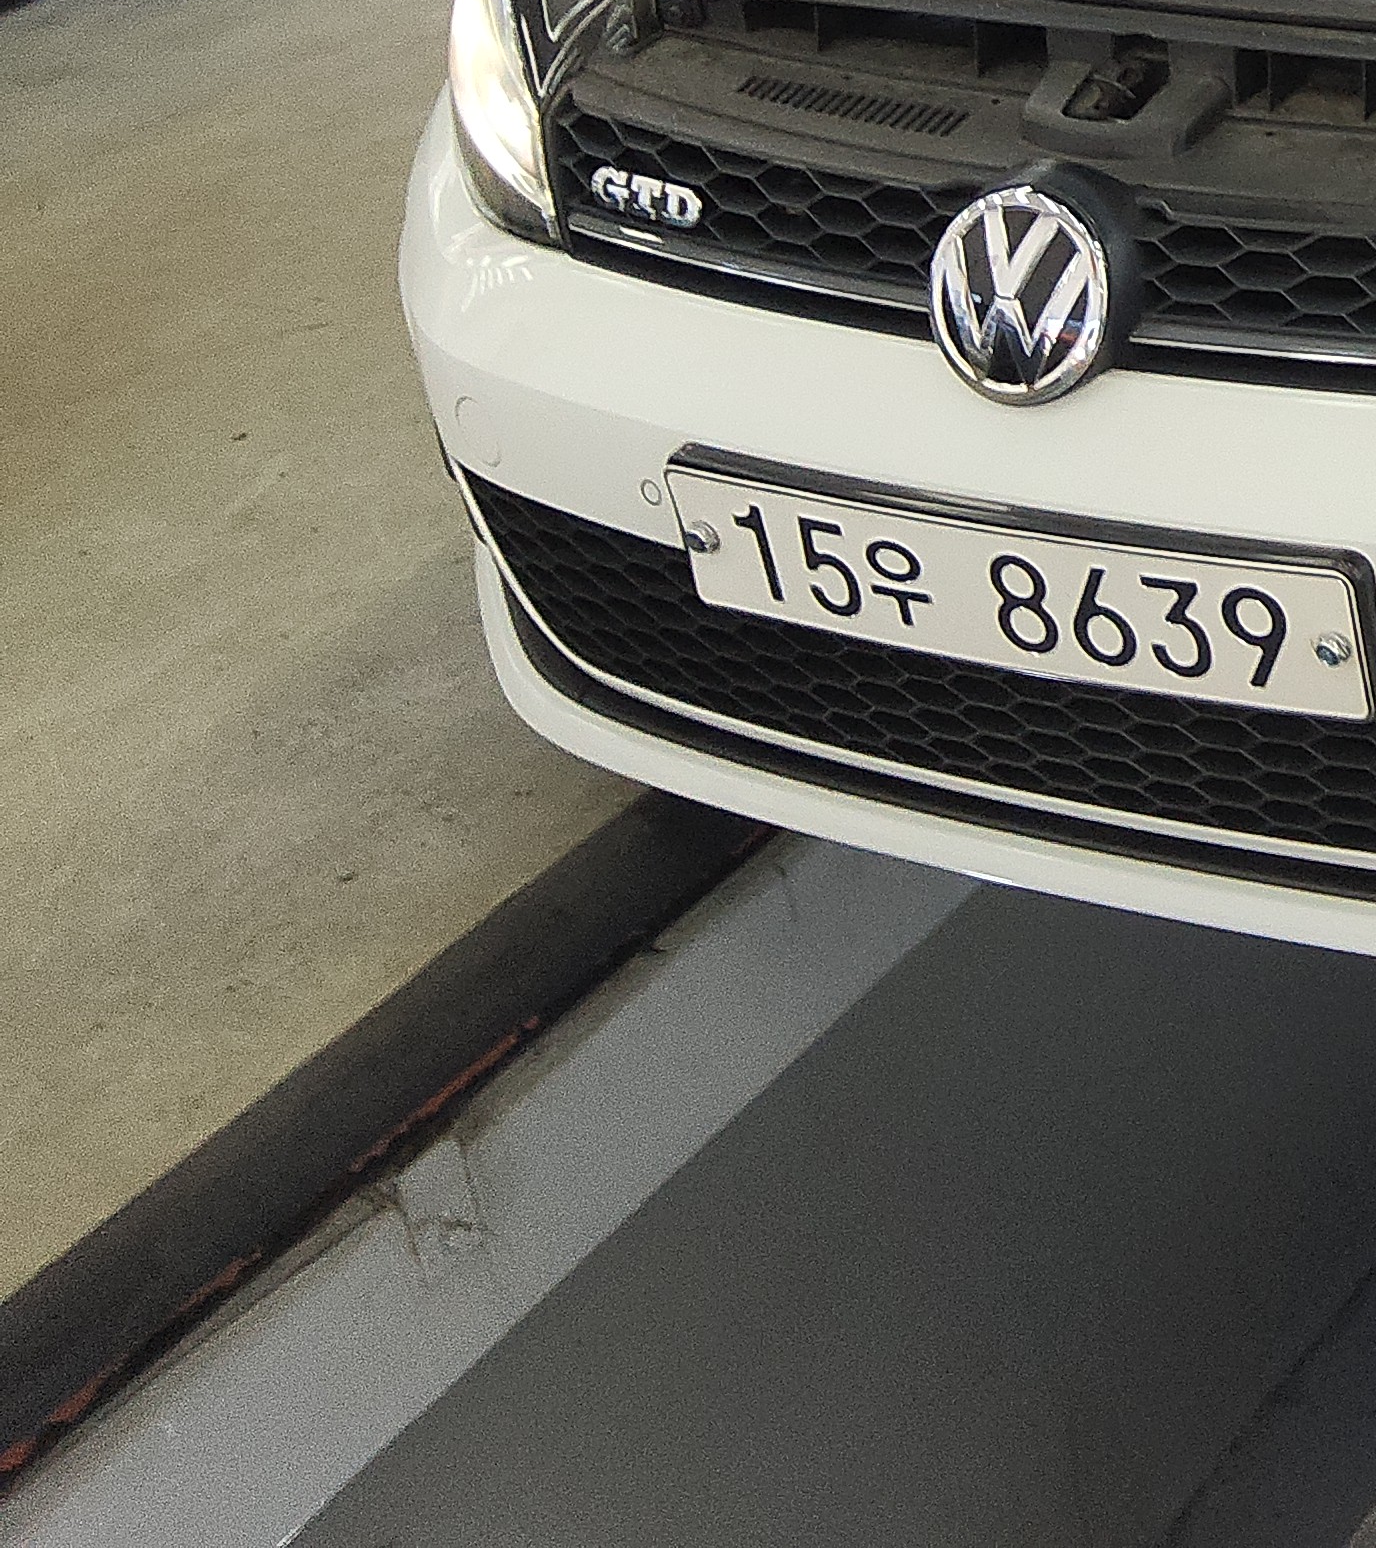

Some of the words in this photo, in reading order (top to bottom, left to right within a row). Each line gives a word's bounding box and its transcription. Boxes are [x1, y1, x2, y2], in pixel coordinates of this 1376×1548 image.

[590, 165, 703, 229] GTD
[732, 503, 933, 628] 15우
[988, 553, 1289, 688] 8639
